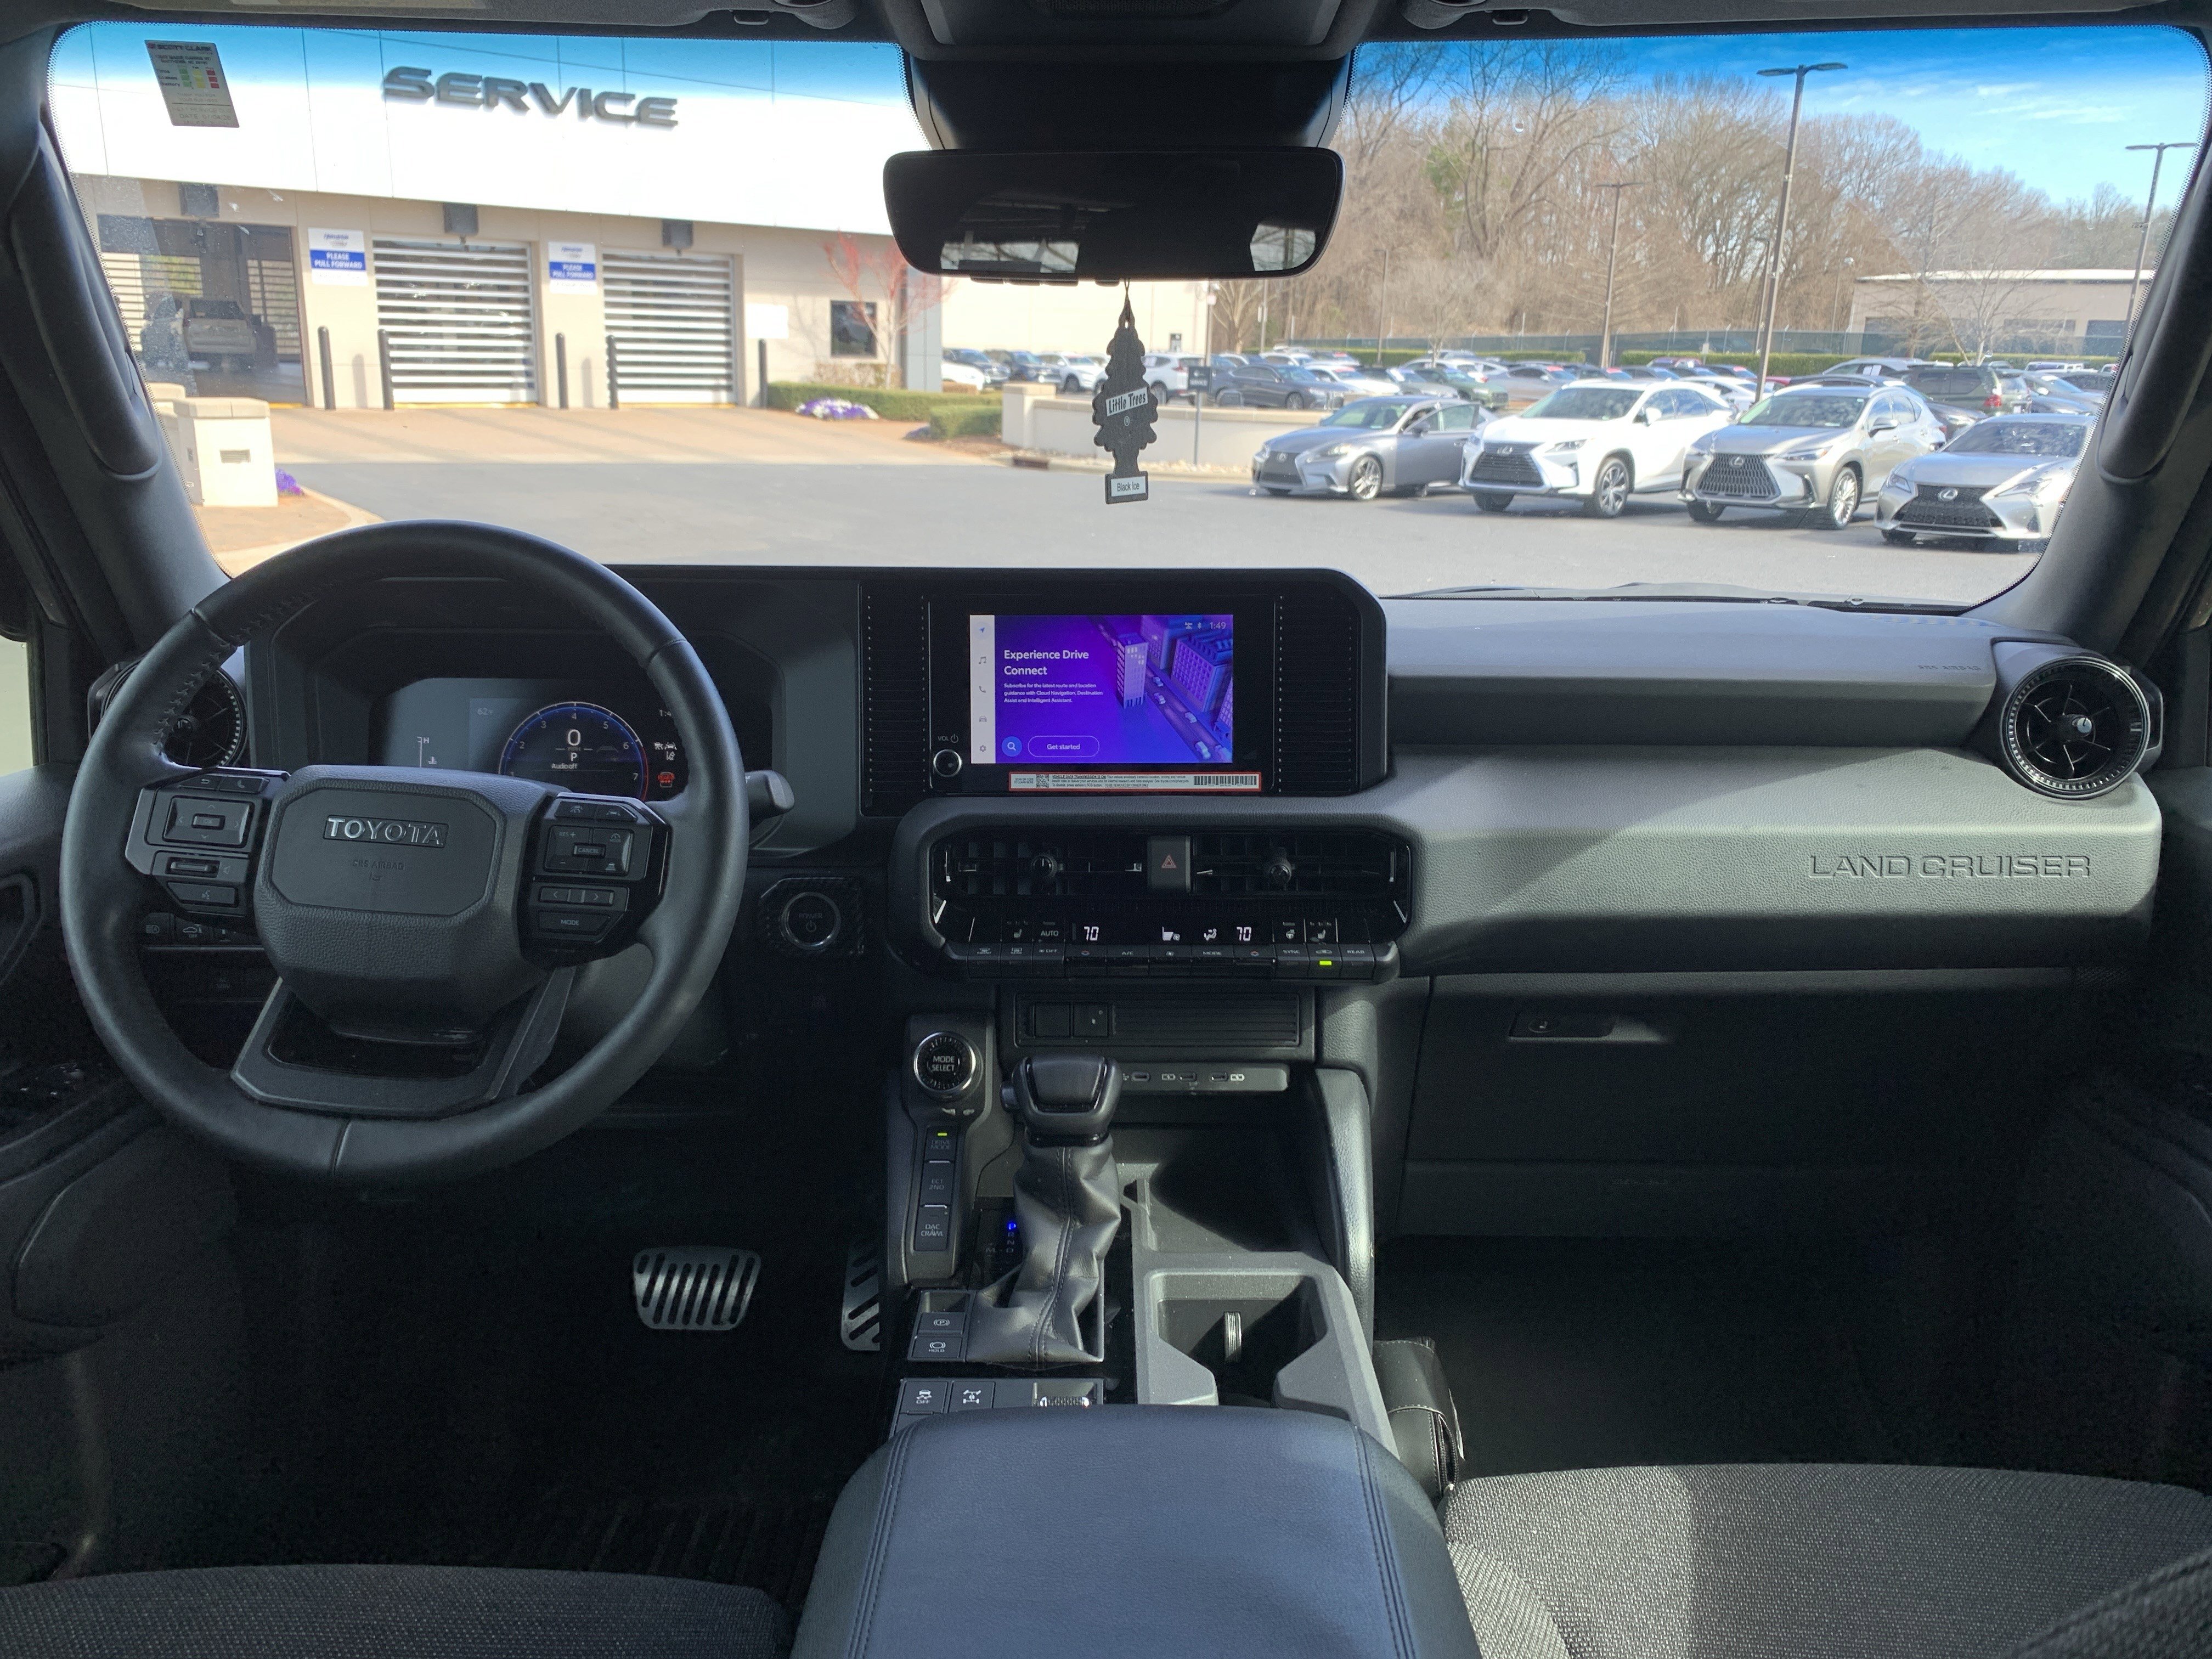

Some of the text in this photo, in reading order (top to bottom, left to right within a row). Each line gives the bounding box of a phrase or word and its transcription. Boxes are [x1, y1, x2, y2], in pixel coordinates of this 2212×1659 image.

[382, 66, 679, 128] SERVICE
[314, 259, 362, 269] PULL FORWARD
[1108, 391, 1147, 414] Little Trees
[1117, 481, 1140, 492] Black Ice
[1210, 621, 1227, 630] 1:49
[1004, 650, 1090, 661] Experience Drive
[1004, 666, 1048, 675] Connect
[603, 721, 608, 730] 5
[568, 729, 580, 746] 0
[571, 752, 577, 761] P
[328, 818, 443, 845] TOYOTA
[353, 859, 405, 870] SRS AIRBAG
[1809, 856, 2090, 878] LAND CRUISER
[1084, 926, 1099, 941] 70
[1237, 926, 1252, 941] 70
